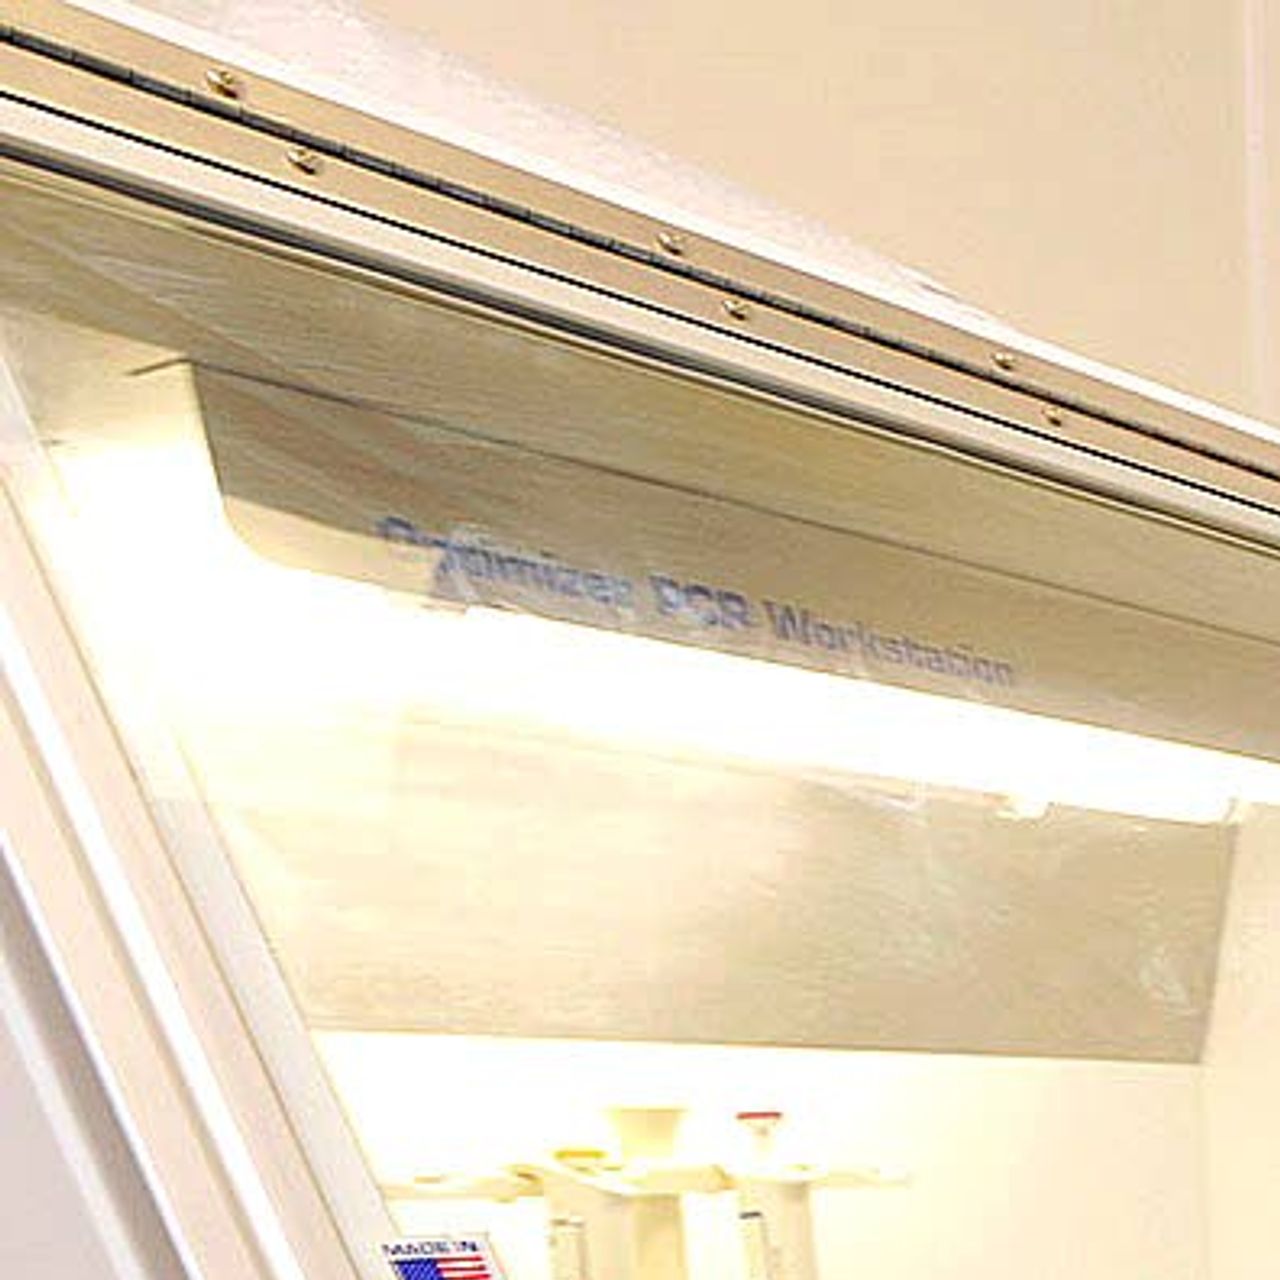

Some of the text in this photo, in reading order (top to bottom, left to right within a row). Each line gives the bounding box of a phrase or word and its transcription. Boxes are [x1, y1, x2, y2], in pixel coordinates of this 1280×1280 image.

[761, 600, 1013, 687] Workstation
[382, 1240, 478, 1255] MADE IN
